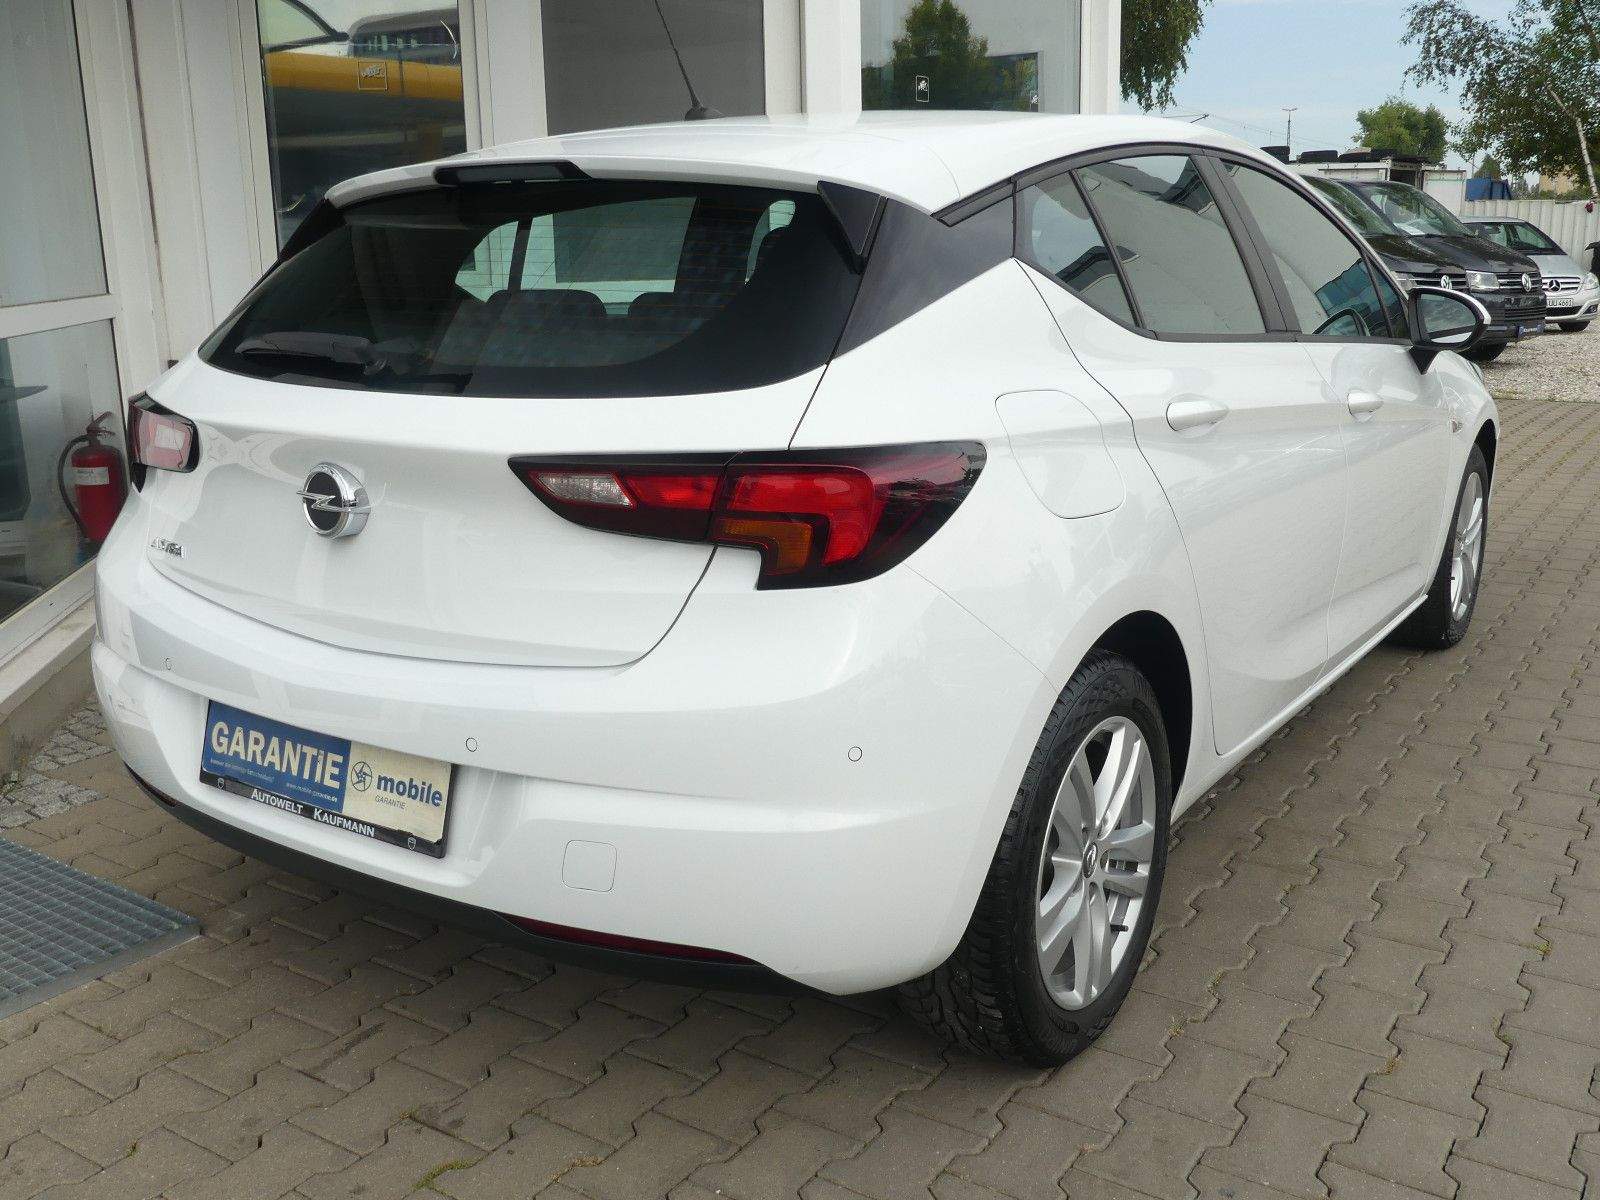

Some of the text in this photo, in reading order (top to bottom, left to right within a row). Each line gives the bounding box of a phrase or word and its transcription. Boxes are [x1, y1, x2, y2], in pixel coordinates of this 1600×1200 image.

[374, 795, 407, 810] GARANTIE
[377, 774, 443, 808] mobile
[250, 788, 376, 838] AUTOWELT KAUFMANN
